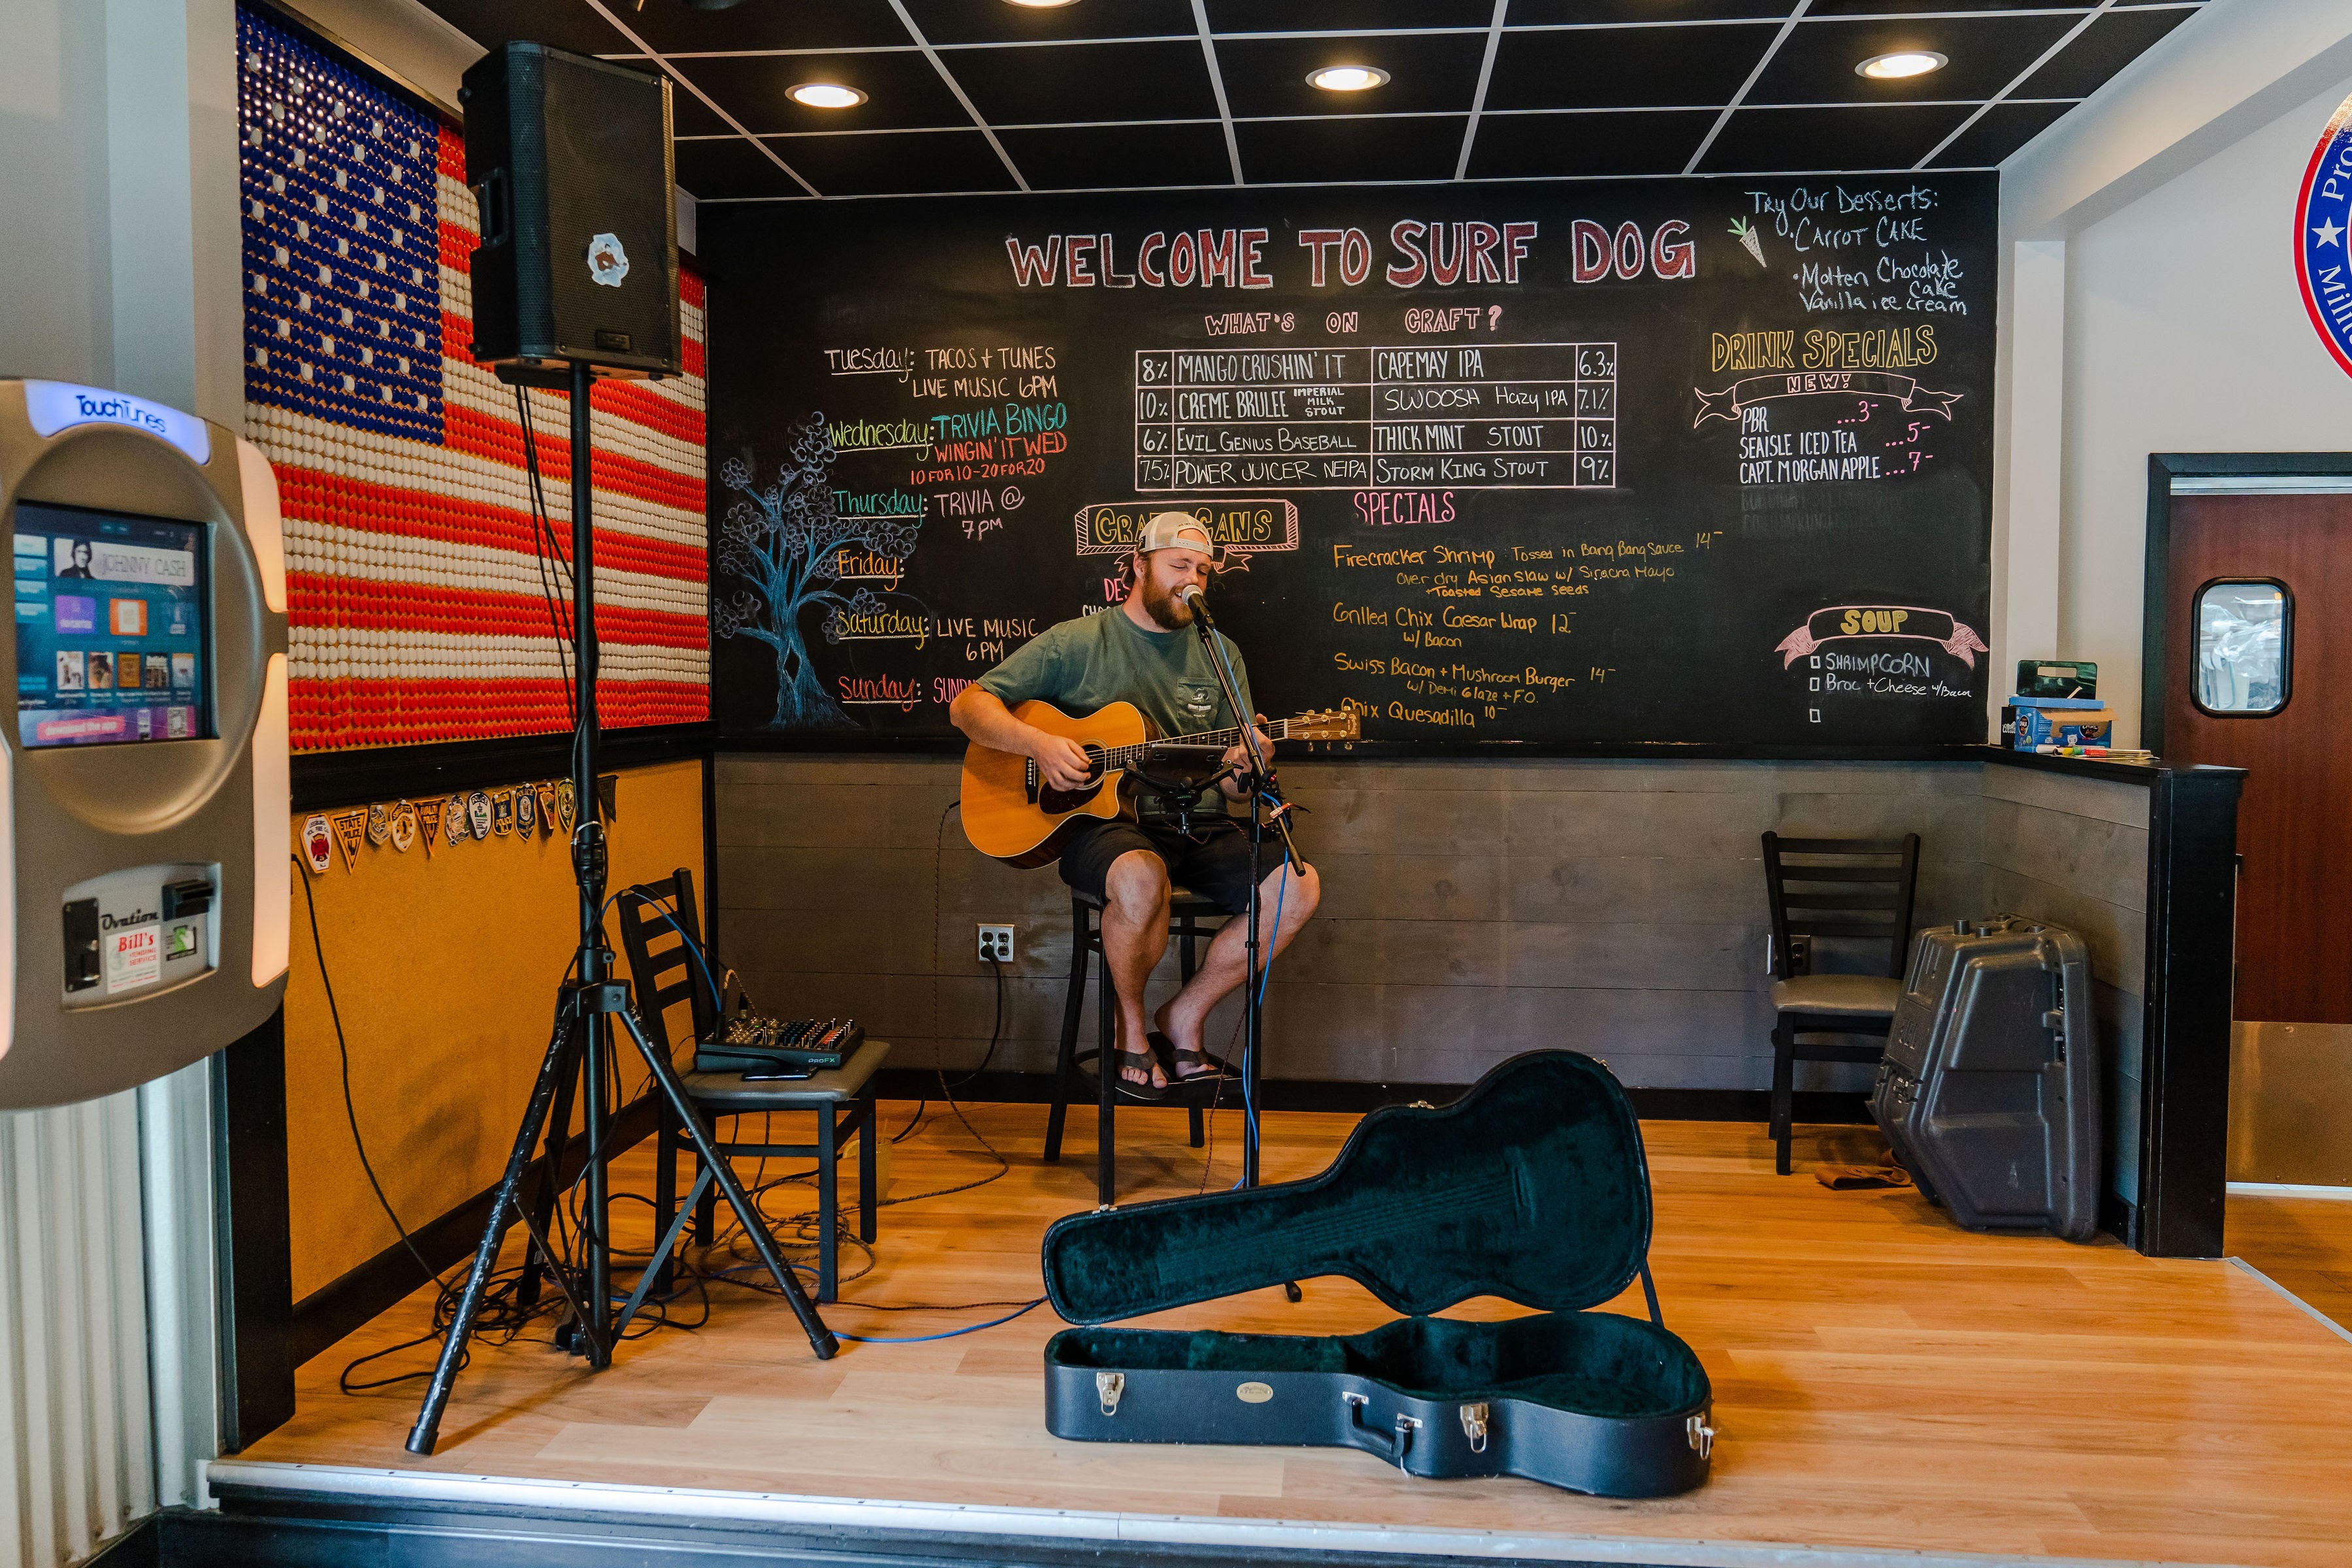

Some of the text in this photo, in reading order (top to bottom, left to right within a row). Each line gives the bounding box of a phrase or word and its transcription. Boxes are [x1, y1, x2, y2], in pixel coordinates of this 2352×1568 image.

[2321, 138, 2352, 202] Pro
[1790, 188, 1829, 212] Our
[1837, 185, 1938, 214] Desserts:
[1005, 219, 1695, 289] WELCOME TO SURF DOG
[1801, 249, 1964, 296] Molten Chocolate
[1799, 290, 1968, 316] Vanilla ice cream
[2319, 265, 2352, 346] Mili
[1205, 304, 1503, 336] WHAT'S ON CRAFT?
[1711, 324, 1938, 372] DRINK SPECIALS
[824, 346, 915, 383] Tuesday:
[924, 350, 977, 370] TACOS
[998, 346, 1056, 370] TUNES
[1143, 351, 1346, 383] 8% MANGO CRUSHIN' IT
[1459, 350, 1484, 378] IPA
[1579, 351, 1614, 377] 6.3%
[913, 374, 1058, 398] LIVE MUSIC 6PM
[1294, 387, 1345, 397] IMPERIAL
[1787, 373, 1852, 393] NEW!
[1140, 391, 1289, 420] 10% CREME BRULEE
[1305, 406, 1345, 417] STOUT
[1307, 397, 1334, 406] MILK
[1495, 386, 1539, 412] Hazy
[1546, 389, 1568, 406] IPA
[1578, 387, 1610, 410] 7.1%
[76, 395, 166, 433] TouchTunes
[1741, 406, 1769, 434] PBR
[830, 402, 1067, 461] Wednesday: TRIVIA BINGO
[1143, 427, 1357, 453] 6% EVIL GENIUS BASEBALL
[1374, 425, 1612, 451] THICK MINT STOUT 10%
[1799, 431, 1829, 455] ICED
[1831, 430, 1857, 453] TEA
[935, 432, 1068, 463] WINGIN' IT WED
[1175, 460, 1237, 484] POWER
[1241, 461, 1317, 482] JUICER
[1324, 460, 1367, 479] NEIPA
[1376, 456, 1609, 483] STORM KING STOUT 9%
[1739, 456, 1881, 484] CAPT. MORGAN APPLE
[832, 485, 1025, 528] Thursday: TRIVIA @
[1354, 491, 1456, 525] SPECIALS
[1096, 508, 1189, 544] CRA
[1333, 540, 1684, 569] Firecracker Shrimp Tossed in Bang Bang Sauce
[838, 549, 904, 591] Friday:
[1396, 572, 1429, 585] Over
[1433, 572, 1458, 590] dry
[1467, 570, 1511, 585] Asian
[1555, 566, 1573, 582] w/
[1634, 566, 1675, 582] Mayo
[1490, 585, 1544, 598] Sesame
[835, 610, 1039, 650] Saturday: LIVE MUSIC
[1395, 607, 1433, 627] Chix
[1443, 605, 1497, 629] Caesar
[1501, 612, 1537, 634] Wrap
[1840, 610, 1908, 634] SOUP
[1403, 630, 1462, 648] w/ Bacon
[1334, 652, 1385, 675] Swiss
[1390, 657, 1435, 679] Bacon
[1452, 664, 1521, 684] Mushroom
[1525, 666, 1575, 693] Burger
[1825, 673, 1861, 691] Broc
[838, 676, 976, 712] Sunday: SUND
[1407, 680, 1424, 694] w/
[1462, 687, 1498, 702] Glaze
[1388, 700, 1475, 728] Quesadilla
[339, 817, 362, 830] STATE
[101, 908, 159, 930] Ovation
[118, 932, 154, 953] Bill's
